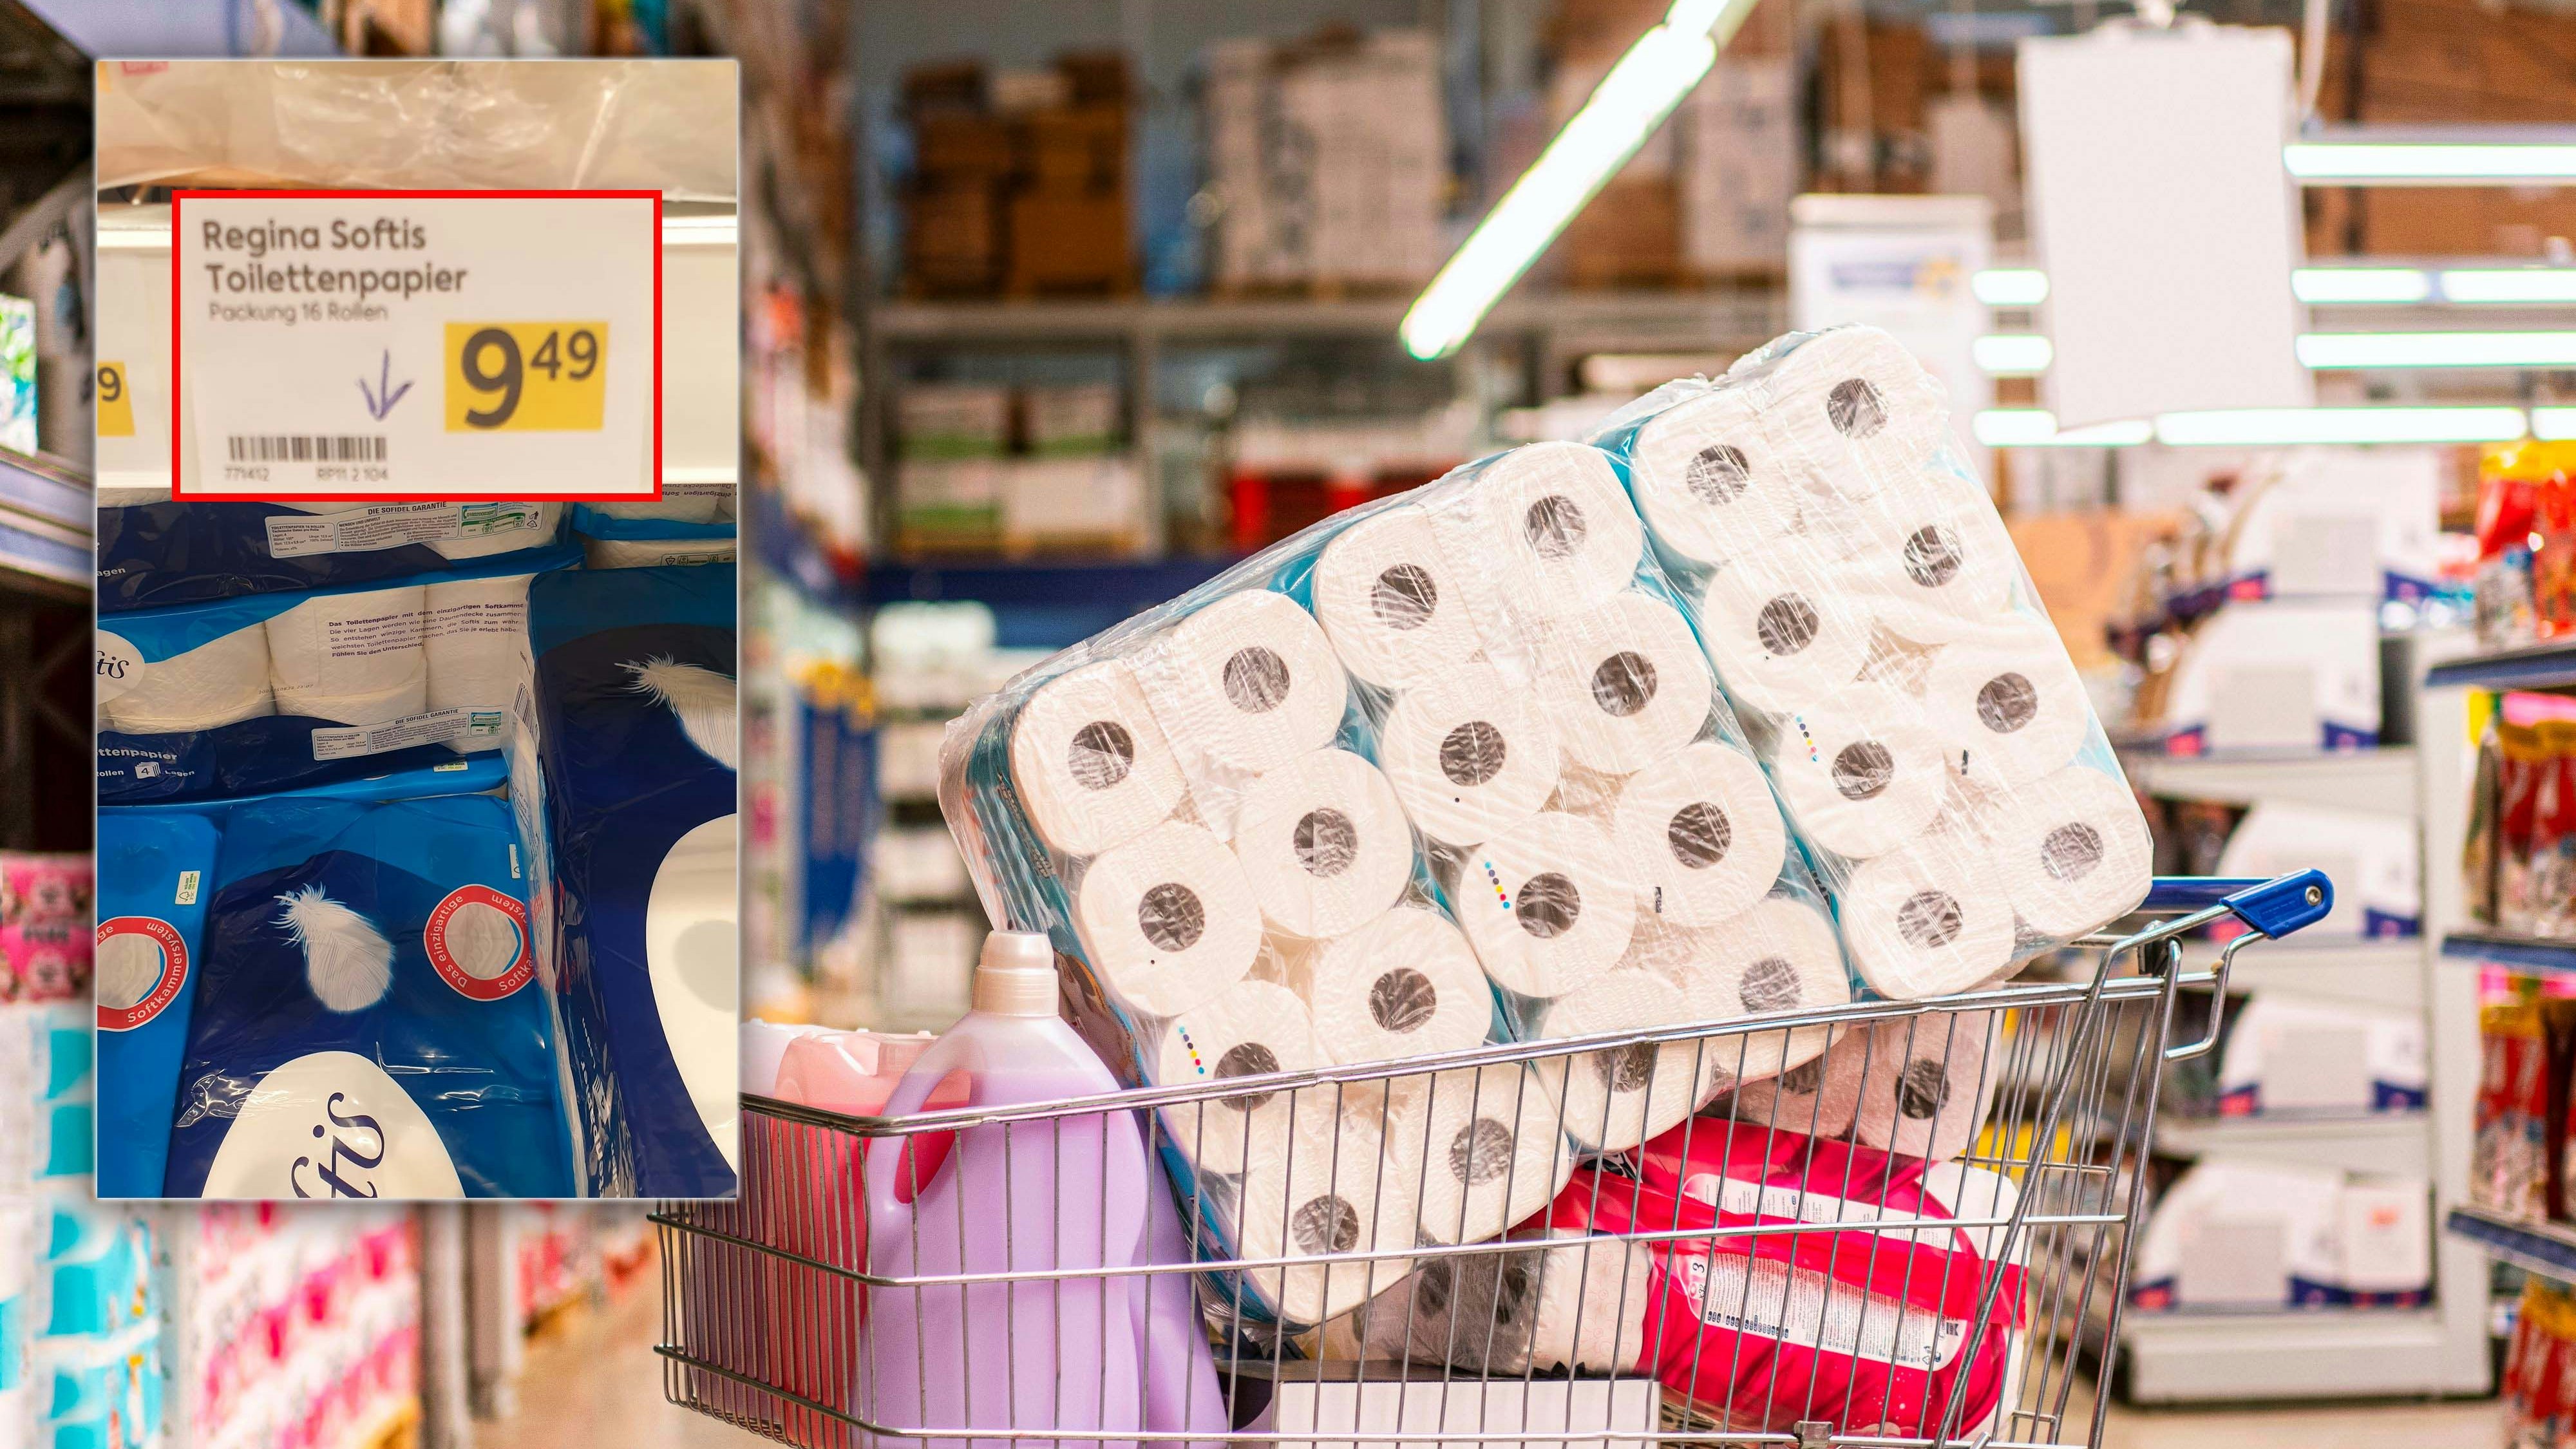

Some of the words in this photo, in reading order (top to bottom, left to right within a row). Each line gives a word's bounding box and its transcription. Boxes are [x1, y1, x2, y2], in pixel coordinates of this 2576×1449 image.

[202, 219, 320, 257] Regina
[330, 217, 426, 249] Softis
[205, 261, 468, 300] Toilettenpapier
[209, 302, 296, 326] Packung
[302, 304, 321, 320] 16
[328, 302, 389, 319] Rollen
[97, 366, 121, 402] 9
[462, 328, 523, 430] 9
[531, 330, 598, 381] 49
[368, 507, 379, 515] DIE
[412, 502, 447, 511] GARANTIE
[346, 614, 398, 625] Toilettenpapier
[437, 604, 480, 614] einzigartigen
[439, 612, 483, 621] Daunendecke
[367, 636, 415, 647] Toilettenpapier
[383, 642, 424, 652] Unterschied.
[97, 650, 129, 679] tis
[430, 709, 459, 718] GARANTIE
[97, 748, 178, 760] ttenpapier
[431, 896, 463, 962] einzigartige
[128, 922, 182, 1023] Softkammersystem
[446, 965, 468, 988] Das
[1692, 1263, 1705, 1273] 3
